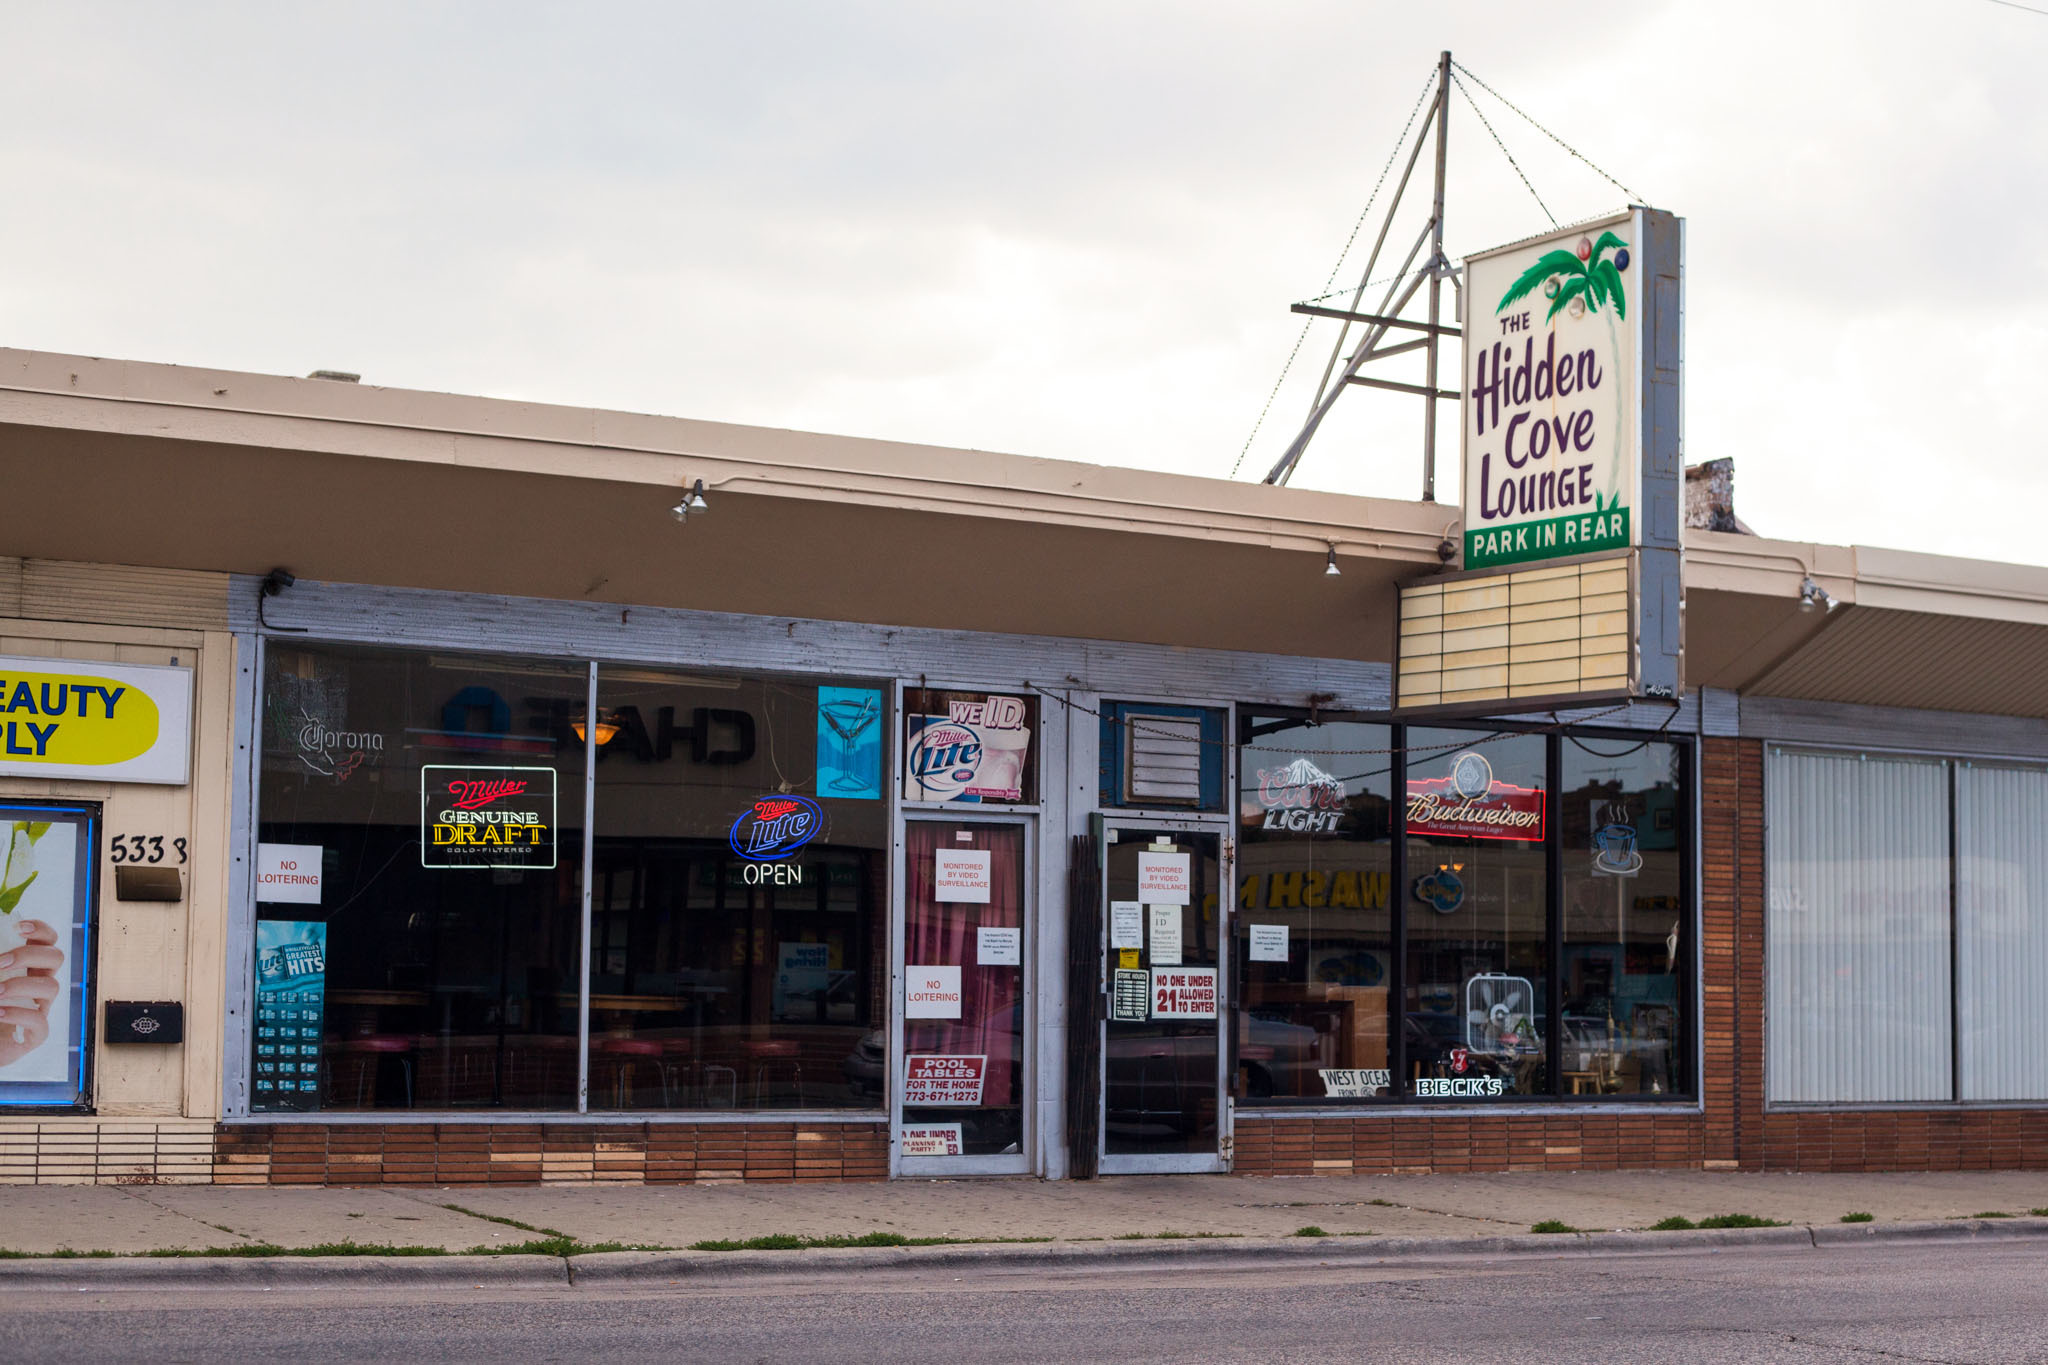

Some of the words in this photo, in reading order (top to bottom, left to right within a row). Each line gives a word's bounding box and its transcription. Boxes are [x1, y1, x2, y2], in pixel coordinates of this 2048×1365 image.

[1500, 312, 1530, 335] THE
[1472, 331, 1602, 436] Hidden
[1505, 409, 1595, 469] Cove
[1474, 525, 1528, 557] PARK
[1536, 519, 1556, 548] IN
[1565, 513, 1623, 544] REAR
[951, 703, 983, 725] WE
[984, 697, 1025, 731] I.D.
[0, 721, 59, 756] LY
[299, 723, 383, 753] Corona
[932, 730, 971, 747] Miller
[914, 743, 981, 777] Lite
[448, 779, 527, 803] Miller
[440, 810, 539, 824] GENUINE
[754, 801, 799, 818] Miller
[1407, 792, 1541, 828] Budweiser
[1263, 808, 1346, 832] LIGHT
[433, 824, 547, 845] DRAFT
[746, 813, 811, 853] Lite
[280, 861, 297, 871] NO
[743, 864, 802, 885] OPEN
[257, 873, 319, 886] LOITERING
[937, 880, 988, 888] SURVEILLANCE
[1140, 883, 1187, 891] SURVEILLANCE
[286, 950, 320, 961] GREATEST
[287, 956, 326, 976] HITS
[926, 981, 941, 989] NO
[1157, 975, 1167, 987] NO
[1170, 975, 1185, 987] ONE
[1188, 975, 1213, 987] UNDER
[908, 993, 959, 1001] LOITERING
[1157, 989, 1177, 1012] 21
[1179, 989, 1214, 1000] ALLOWED
[1178, 1002, 1188, 1013] TO
[1190, 1002, 1215, 1013] ENTER
[924, 1059, 968, 1068] POOL
[915, 1069, 976, 1077] TABLES
[1325, 1071, 1355, 1085] WEST
[906, 1081, 926, 1089] FOR
[930, 1081, 949, 1089] THE
[952, 1081, 980, 1089] HOME
[1416, 1075, 1502, 1096] BECK'S
[905, 1092, 978, 1101] 773-671-1273
